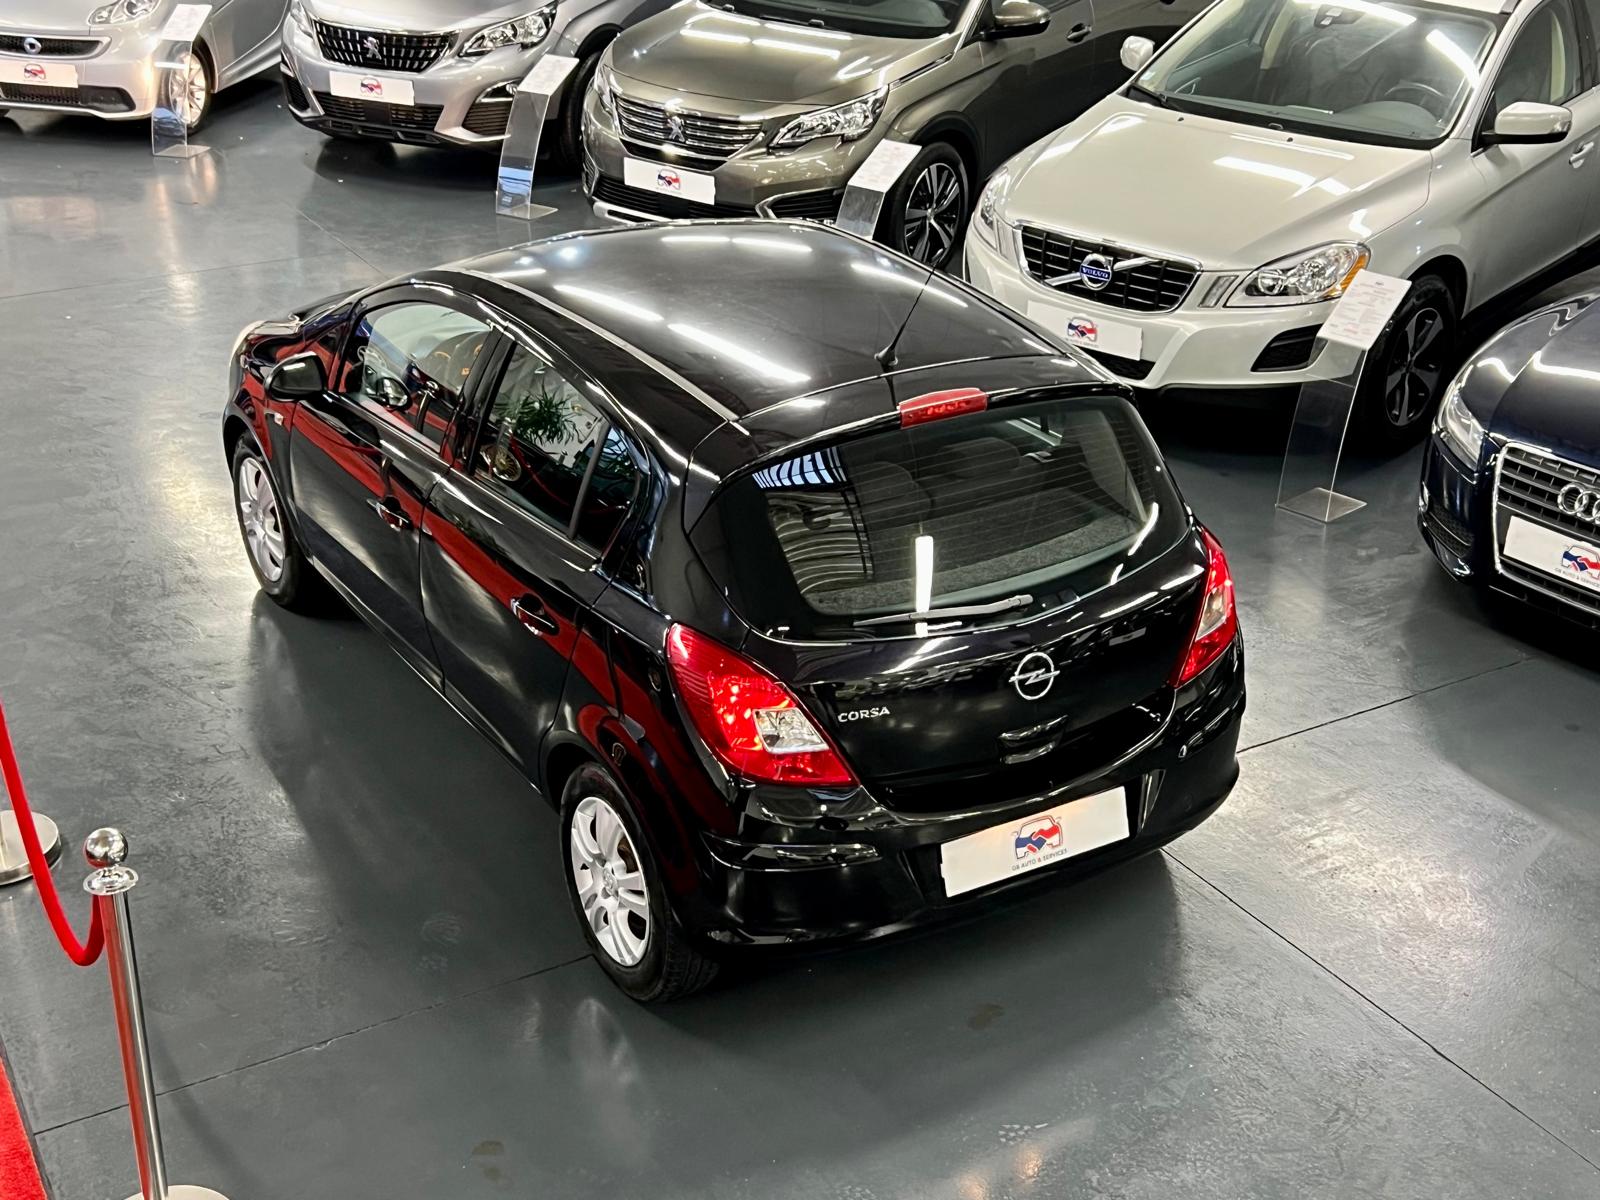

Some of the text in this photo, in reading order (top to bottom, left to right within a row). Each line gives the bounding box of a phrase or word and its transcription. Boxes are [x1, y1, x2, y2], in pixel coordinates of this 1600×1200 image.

[1082, 267, 1109, 279] VOLVO
[837, 706, 891, 723] CORSA
[1021, 858, 1036, 868] AUTO
[1043, 848, 1067, 861] SERVICES
